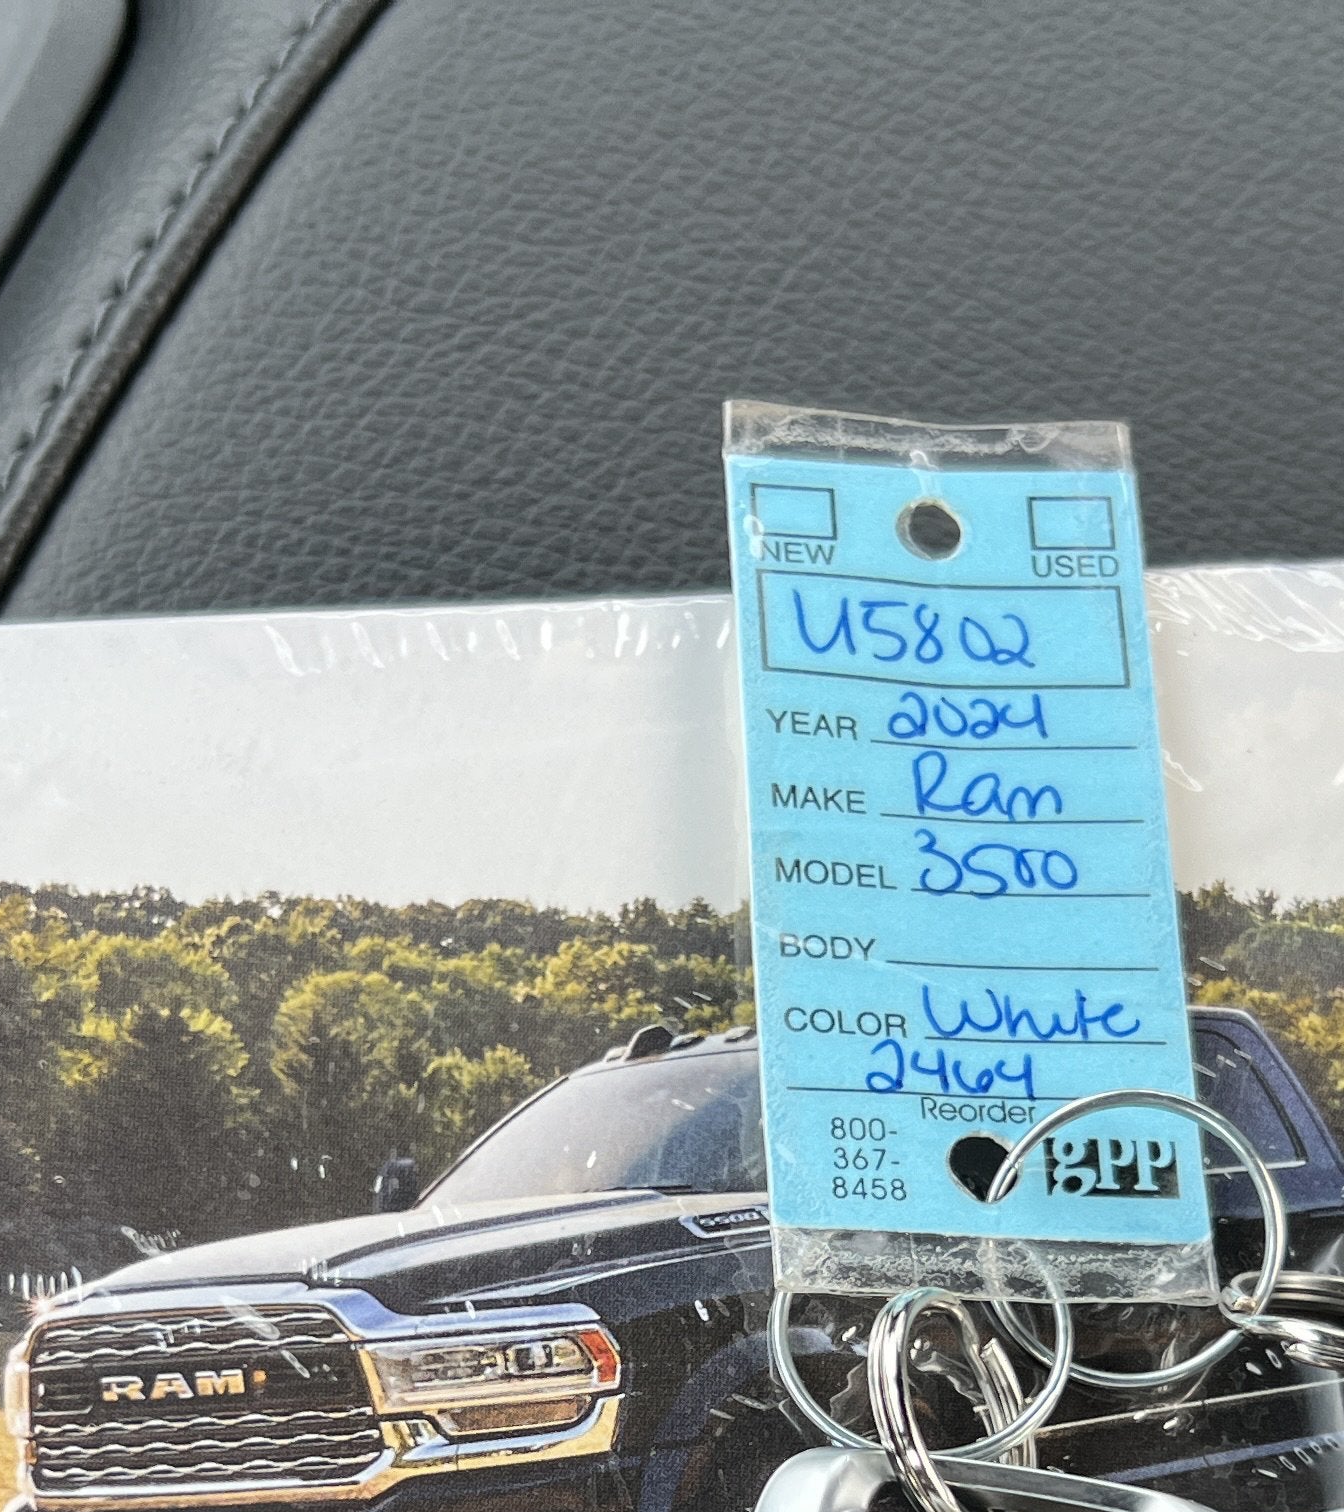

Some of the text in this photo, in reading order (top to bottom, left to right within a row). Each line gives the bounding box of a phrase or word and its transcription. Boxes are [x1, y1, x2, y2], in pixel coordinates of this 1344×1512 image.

[758, 541, 836, 565] NEW
[1030, 555, 1120, 578] USED
[766, 709, 858, 740] YEAR
[887, 692, 1049, 740] 2024
[770, 783, 867, 815] MAKE
[912, 750, 1063, 822] Ram
[775, 857, 898, 890] MODEL
[914, 829, 1078, 898] 3500
[779, 934, 876, 961] BODY
[784, 1007, 907, 1038] COLOR
[922, 984, 1141, 1041] White
[865, 1039, 1035, 1099] 2464
[920, 1097, 1036, 1124] Reorder
[831, 1117, 898, 1141] 800-
[833, 1147, 901, 1171] 367-
[1052, 1136, 1176, 1197] gpp
[832, 1178, 907, 1201] 8458
[100, 1369, 246, 1401] RAM
